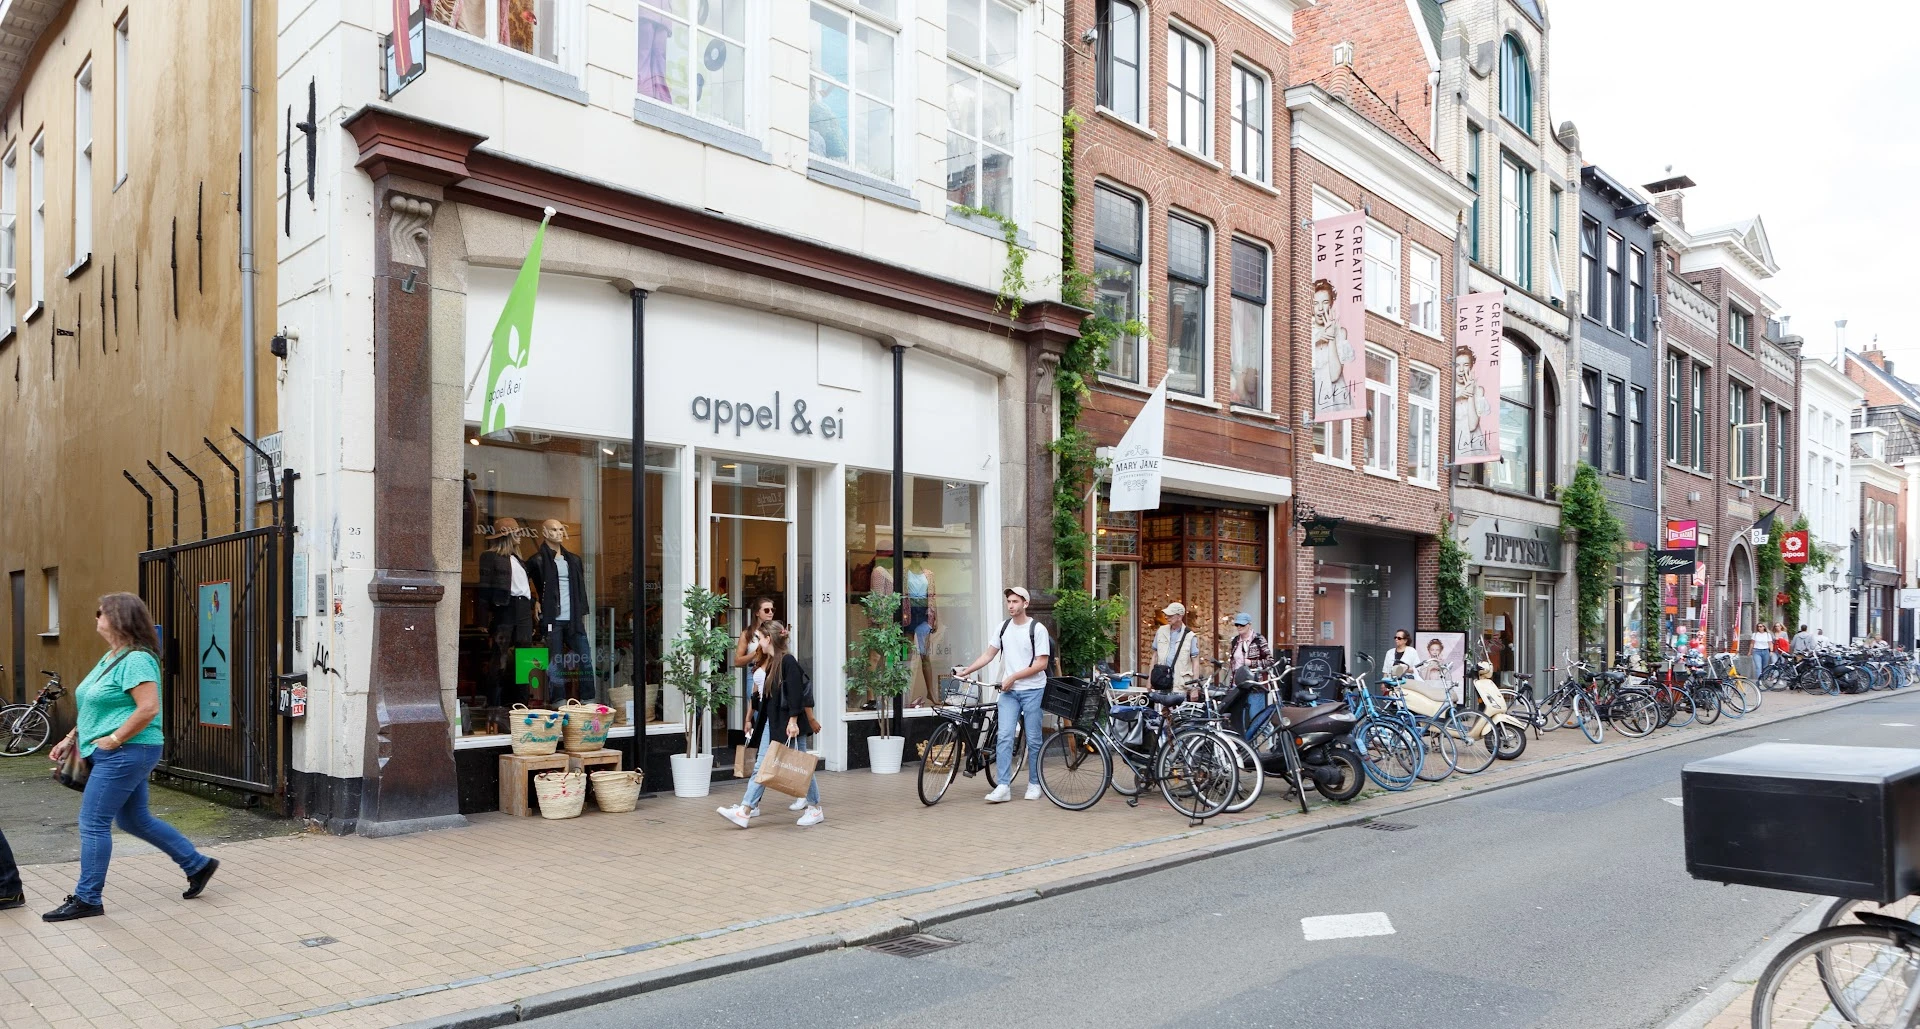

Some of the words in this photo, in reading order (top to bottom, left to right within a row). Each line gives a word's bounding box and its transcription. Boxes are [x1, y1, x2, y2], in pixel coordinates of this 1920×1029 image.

[1317, 233, 1327, 262] LAB
[1335, 229, 1345, 268] NAIL
[1352, 225, 1363, 303] CREATIVE
[1459, 307, 1468, 331] LAB
[1475, 305, 1484, 337] NAIL
[1490, 302, 1501, 367] CREATIVE
[507, 381, 513, 395] &
[692, 391, 780, 437] appel
[791, 398, 813, 435] &
[820, 407, 844, 440] ei
[1116, 461, 1137, 472] MARY
[1140, 460, 1158, 470] JANE
[348, 526, 361, 536] 25
[1485, 532, 1551, 567] FIFTYSIX
[822, 593, 831, 603] 25
[294, 704, 303, 714] XL
